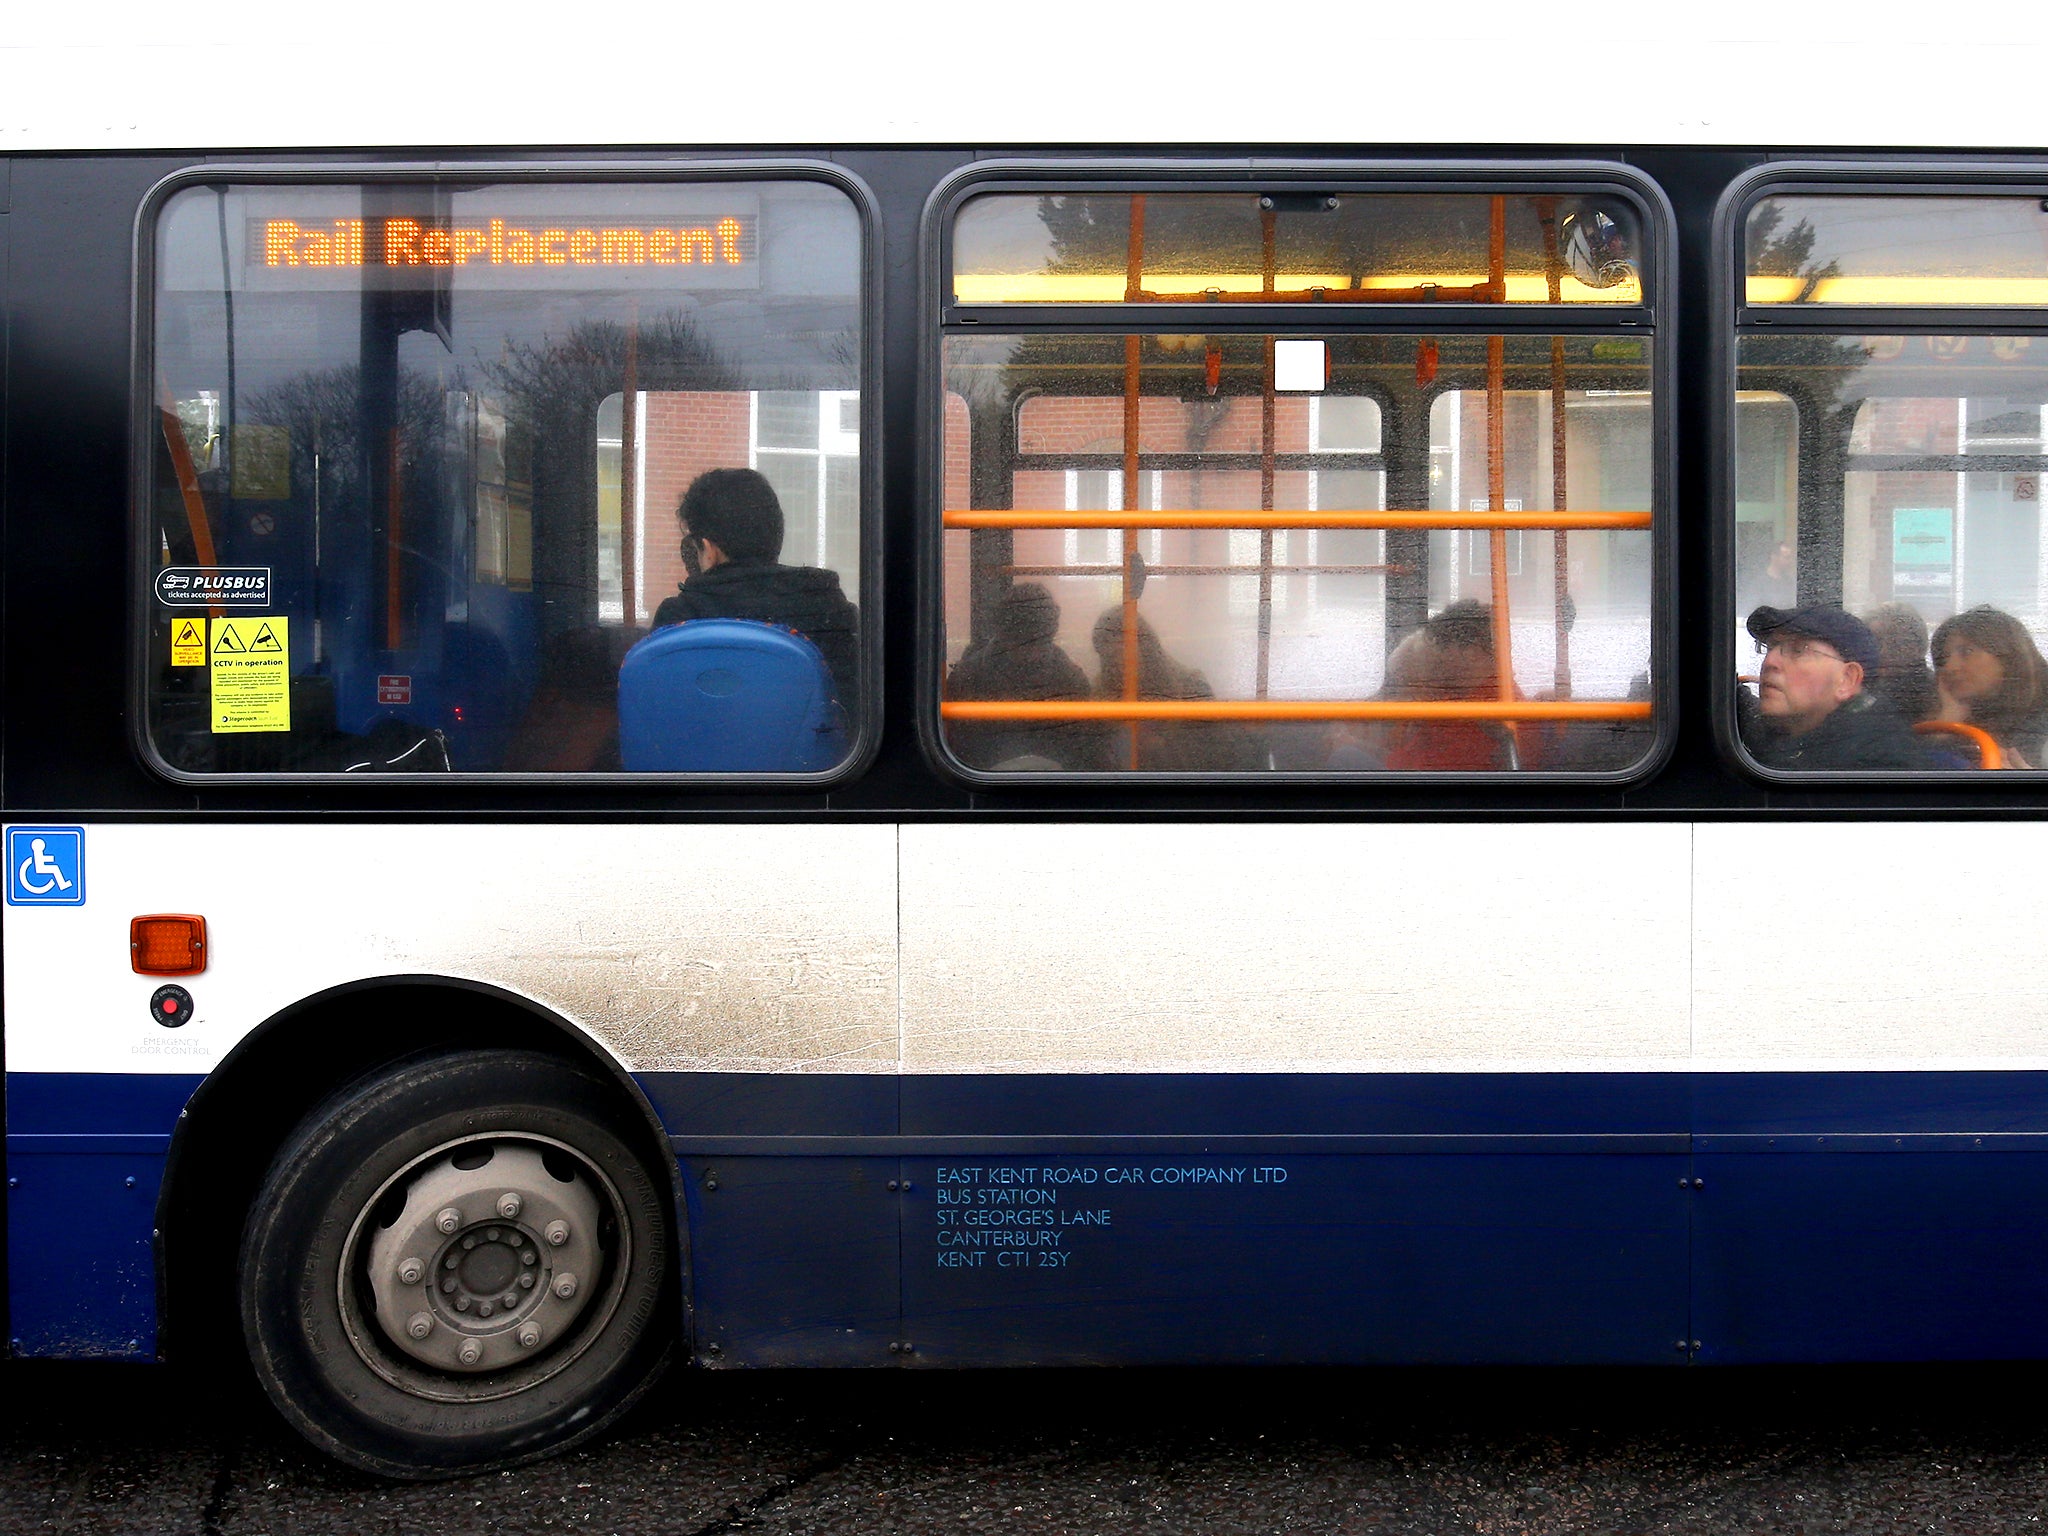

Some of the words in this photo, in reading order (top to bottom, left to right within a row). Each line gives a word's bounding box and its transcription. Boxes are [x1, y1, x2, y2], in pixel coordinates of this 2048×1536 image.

[265, 219, 363, 267] Rail
[385, 217, 743, 266] Replacement
[192, 576, 266, 589] PLUSBUS
[168, 591, 190, 599] tickets
[190, 591, 221, 600] accepted
[230, 591, 266, 599] advertised
[245, 659, 283, 668] operation
[159, 988, 184, 997] EMERGENCY
[143, 1037, 200, 1046] EMERGENCY
[131, 1046, 161, 1055] DOOR
[164, 1046, 210, 1056] CONTROL
[937, 1168, 980, 1184] EAST
[988, 1168, 1037, 1184] KENT
[1043, 1168, 1098, 1184] ROAD
[1104, 1168, 1145, 1184] CAR
[1151, 1168, 1247, 1184] COMPANY
[1254, 1168, 1288, 1184] LTD
[937, 1189, 972, 1204] BUS
[977, 1189, 1056, 1204] STATION
[937, 1210, 959, 1225] ST.
[964, 1210, 1054, 1225] GEORGE'S
[1061, 1210, 1111, 1225] LANE
[937, 1231, 1063, 1247] CANTERBURY
[937, 1252, 986, 1267] KENT
[1038, 1252, 1071, 1267] 2SY
